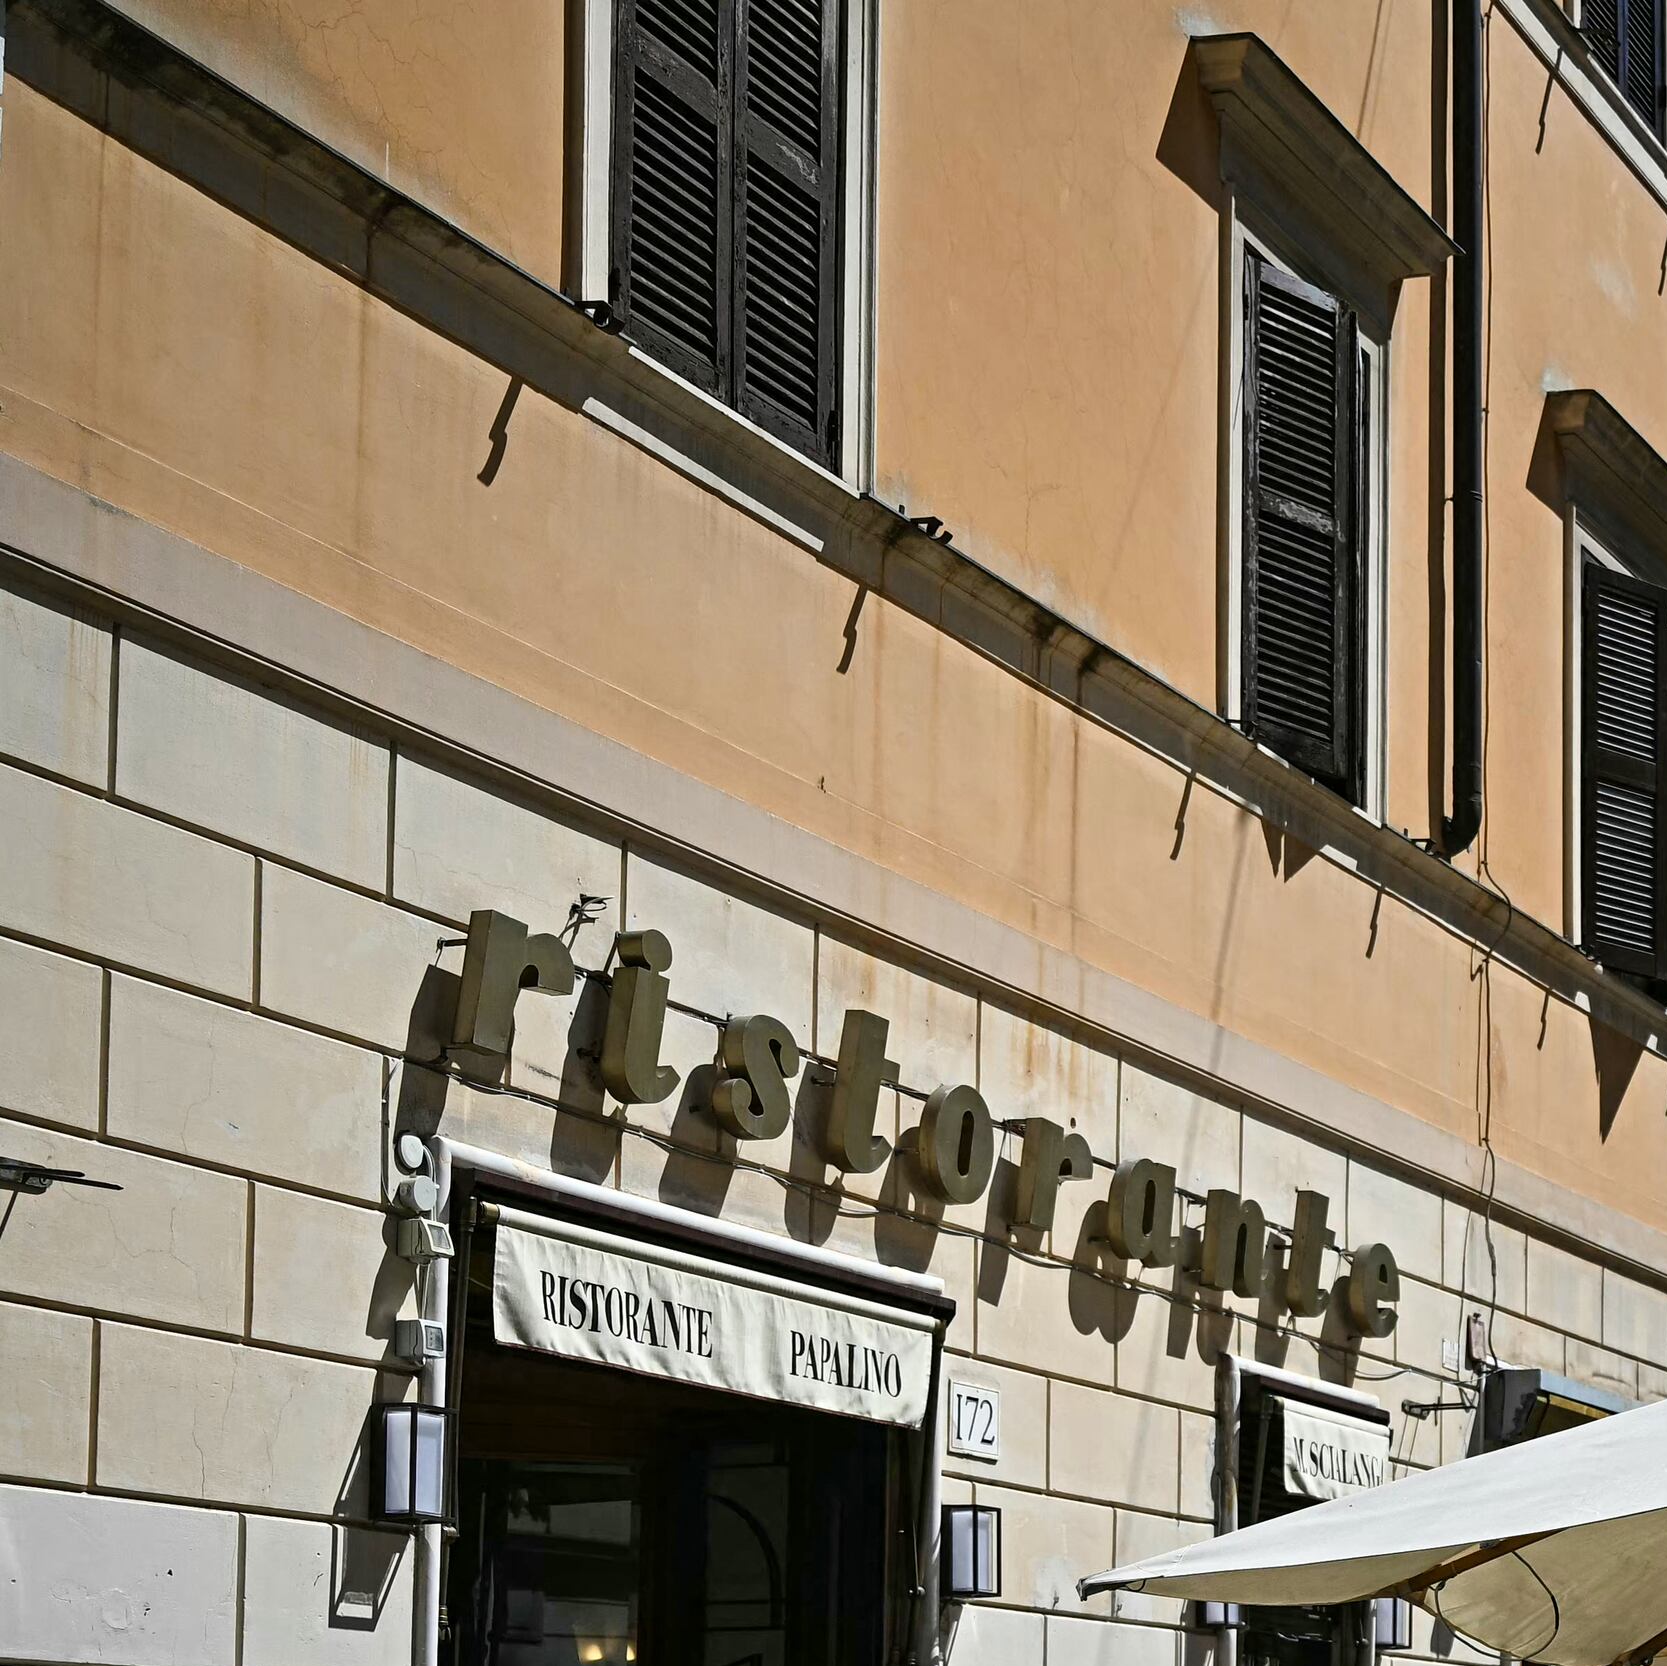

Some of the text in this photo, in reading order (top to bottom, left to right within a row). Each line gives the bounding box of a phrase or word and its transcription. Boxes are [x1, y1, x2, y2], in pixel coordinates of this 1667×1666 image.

[449, 909, 1400, 1338] ristorante
[540, 1269, 902, 1398] RISTORANTE PAPALINO
[954, 1388, 997, 1447] 172
